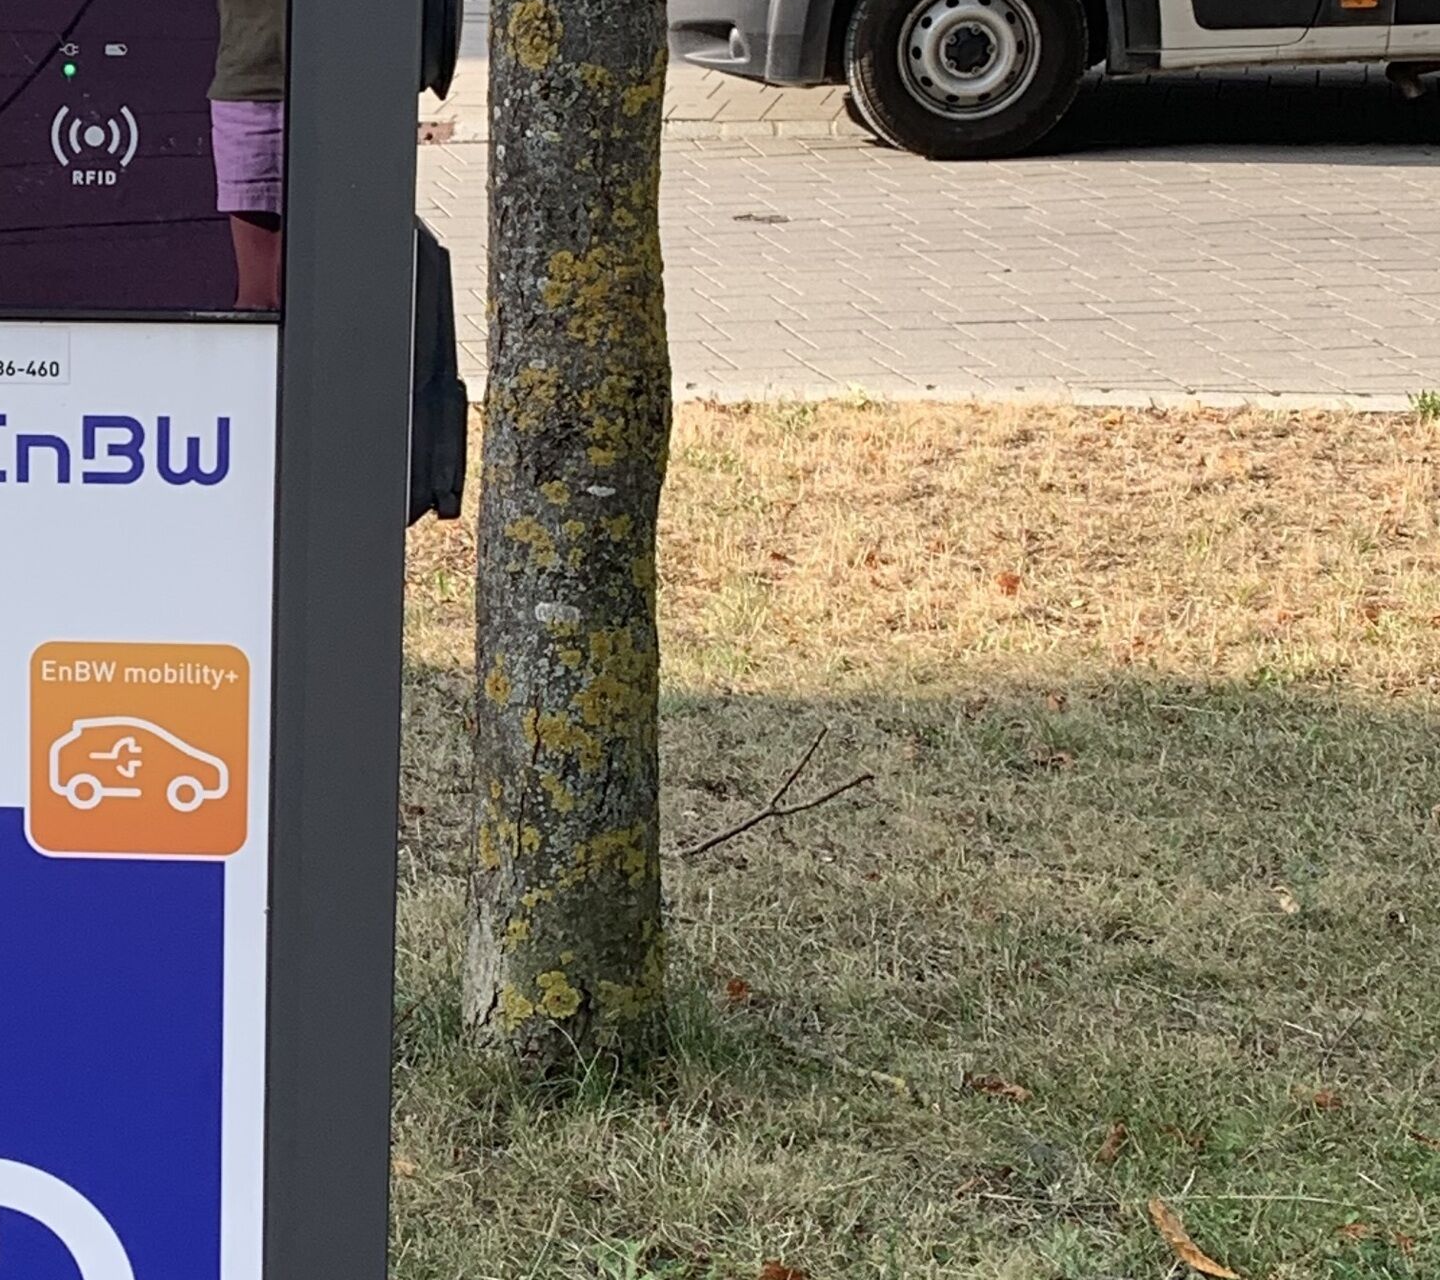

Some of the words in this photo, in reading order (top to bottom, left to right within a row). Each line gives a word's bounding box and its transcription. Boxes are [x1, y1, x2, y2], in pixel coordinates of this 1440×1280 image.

[72, 170, 116, 185] RFID
[41, 660, 117, 683] EnBW
[124, 662, 240, 690] mobility+
